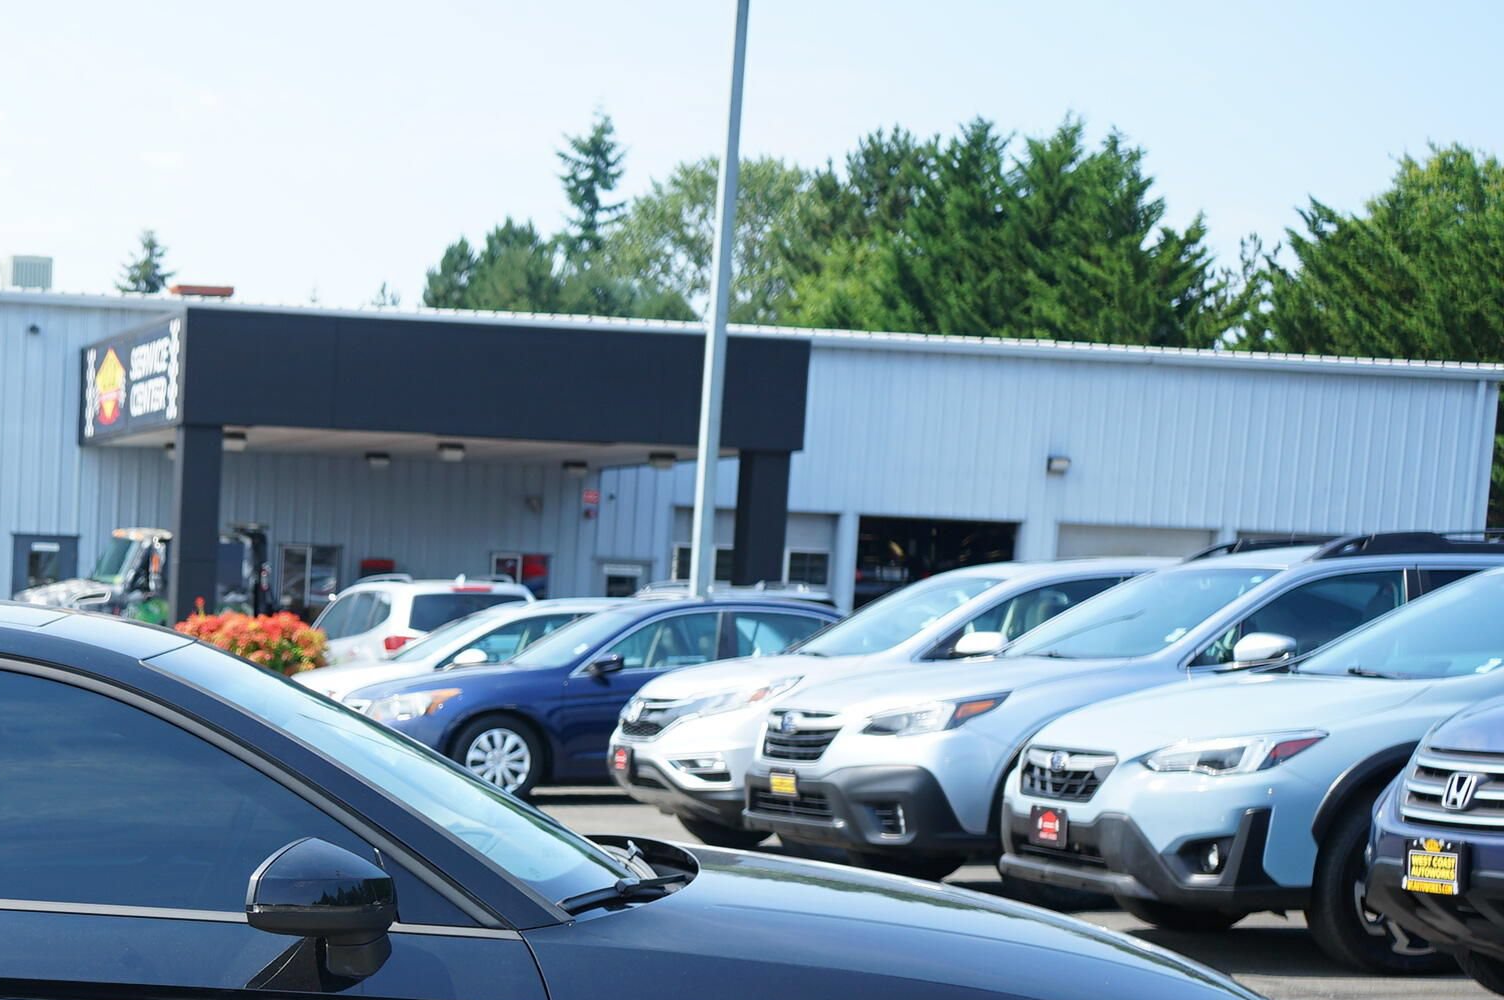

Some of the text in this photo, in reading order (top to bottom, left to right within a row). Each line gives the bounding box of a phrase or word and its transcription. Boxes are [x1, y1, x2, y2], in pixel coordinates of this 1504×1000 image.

[129, 376, 167, 417] CENTER
[1411, 854, 1456, 870] WEST COAST
[1410, 866, 1455, 881] AUTOWORKS
